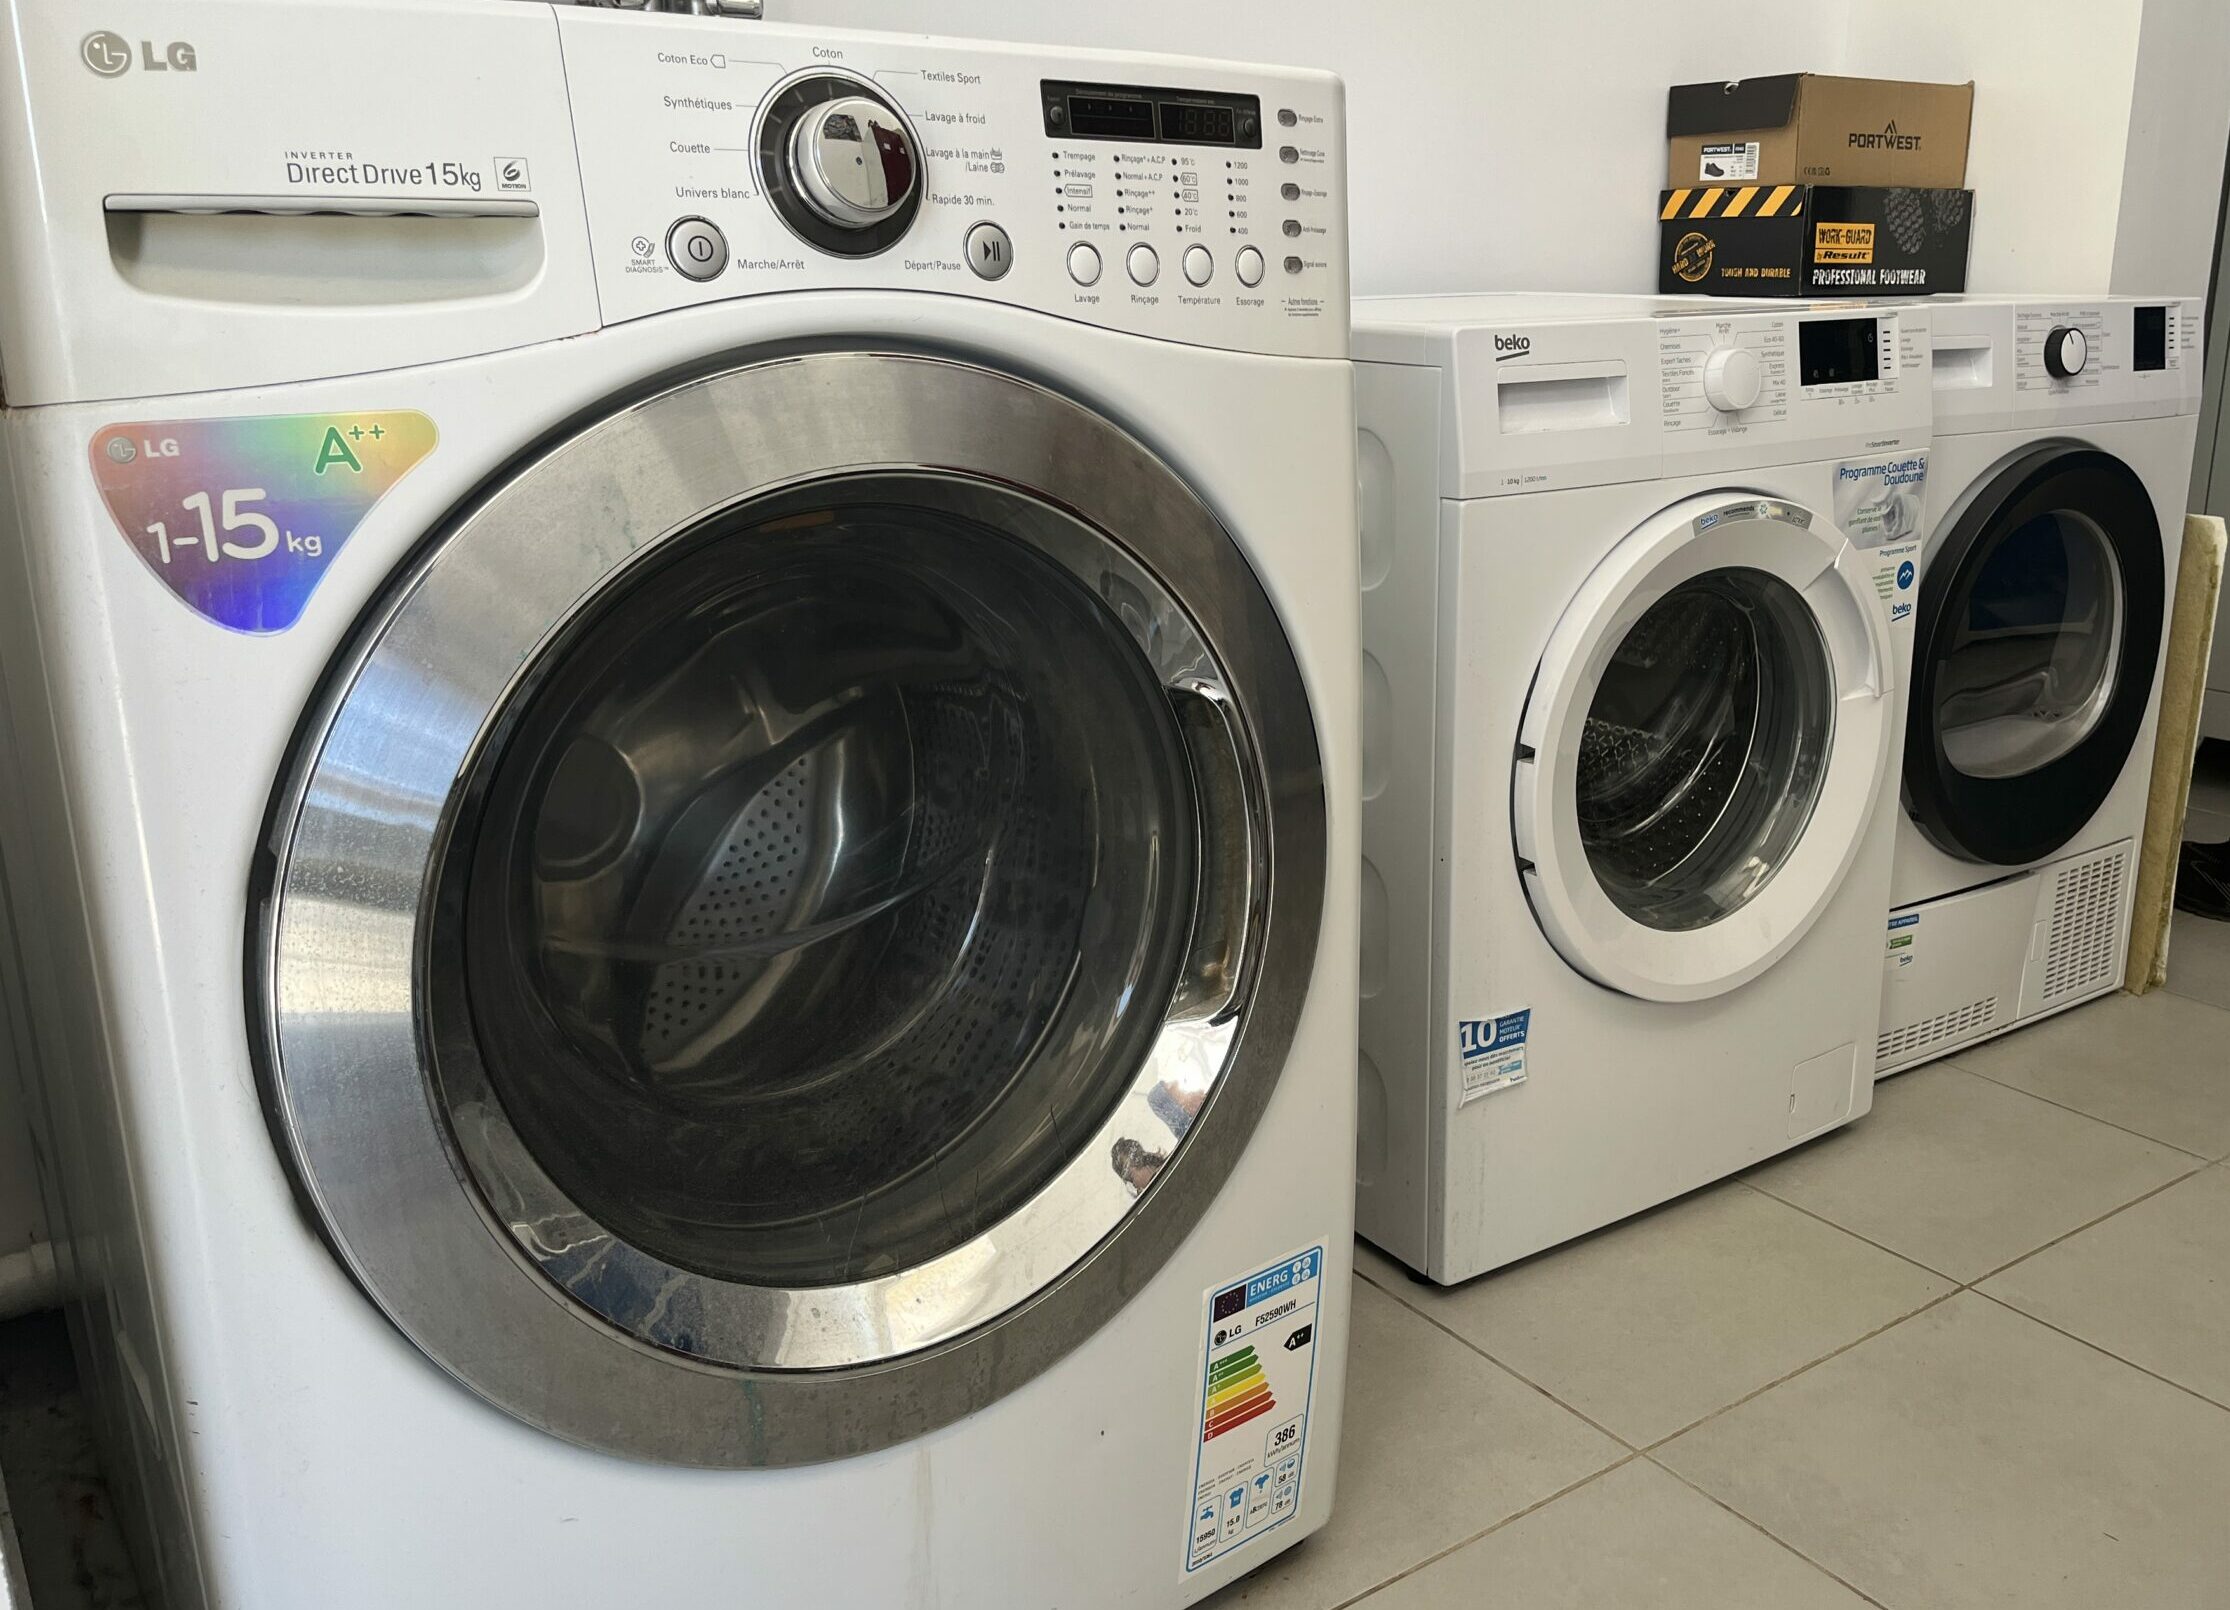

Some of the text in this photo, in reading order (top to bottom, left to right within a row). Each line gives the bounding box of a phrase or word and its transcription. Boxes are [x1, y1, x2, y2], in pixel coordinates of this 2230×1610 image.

[141, 41, 198, 72] LG
[657, 53, 708, 66] Coton Eco
[812, 47, 844, 59] Coton
[921, 69, 981, 86] Textiles Sport
[663, 95, 733, 112] Synthétiques
[925, 111, 986, 126] Lavage à froid
[669, 141, 711, 154] Couette
[1849, 133, 1920, 151] PORTWEST
[284, 151, 354, 161] INVERTER
[926, 147, 989, 160] Lavage à la main
[1063, 150, 1096, 161] Trempage
[1233, 161, 1248, 170] 1200
[287, 163, 360, 184] Direct
[364, 163, 422, 185] Drive
[1064, 169, 1096, 180] Prélavage
[1122, 171, 1143, 180] Normal
[1234, 178, 1249, 186] 1000
[676, 186, 750, 199] Univers blanc
[1066, 187, 1091, 196] Intensif
[932, 193, 995, 206] Rapide 30 min.
[1067, 203, 1092, 213] Normal
[1069, 221, 1110, 231] Gain de temps
[1127, 222, 1150, 231] Normal
[1185, 224, 1202, 233] Froid
[1237, 227, 1249, 235] 400
[1818, 228, 1873, 246] WORK-GUARD
[631, 259, 656, 267] SMART
[737, 258, 805, 270] Marche/Arrêt
[904, 258, 962, 271] Départ/Pause
[1761, 268, 1791, 278] DURABLE
[1813, 268, 1926, 285] PROFESSIONAL FOOTWEAR
[1074, 294, 1100, 304] Lavage
[1131, 294, 1159, 305] Rinçage
[1178, 294, 1221, 306] Température
[1236, 296, 1265, 307] Essorage
[1494, 333, 1530, 351] beko
[143, 438, 181, 459] LG
[313, 424, 386, 476] A++
[1840, 457, 1926, 481] Programme Couette &
[1884, 471, 1924, 486] Doudoune
[1700, 514, 1719, 525] beko
[285, 530, 323, 557] kg
[1879, 545, 1917, 557] Programme Sport
[1892, 602, 1912, 615] beko
[1460, 1021, 1497, 1053] 10
[1499, 1031, 1525, 1043] OFFERTS
[1250, 1270, 1289, 1297] ENERG
[1228, 1324, 1242, 1338] LG
[1208, 1420, 1214, 1428] C
[1274, 1424, 1296, 1446] 386
